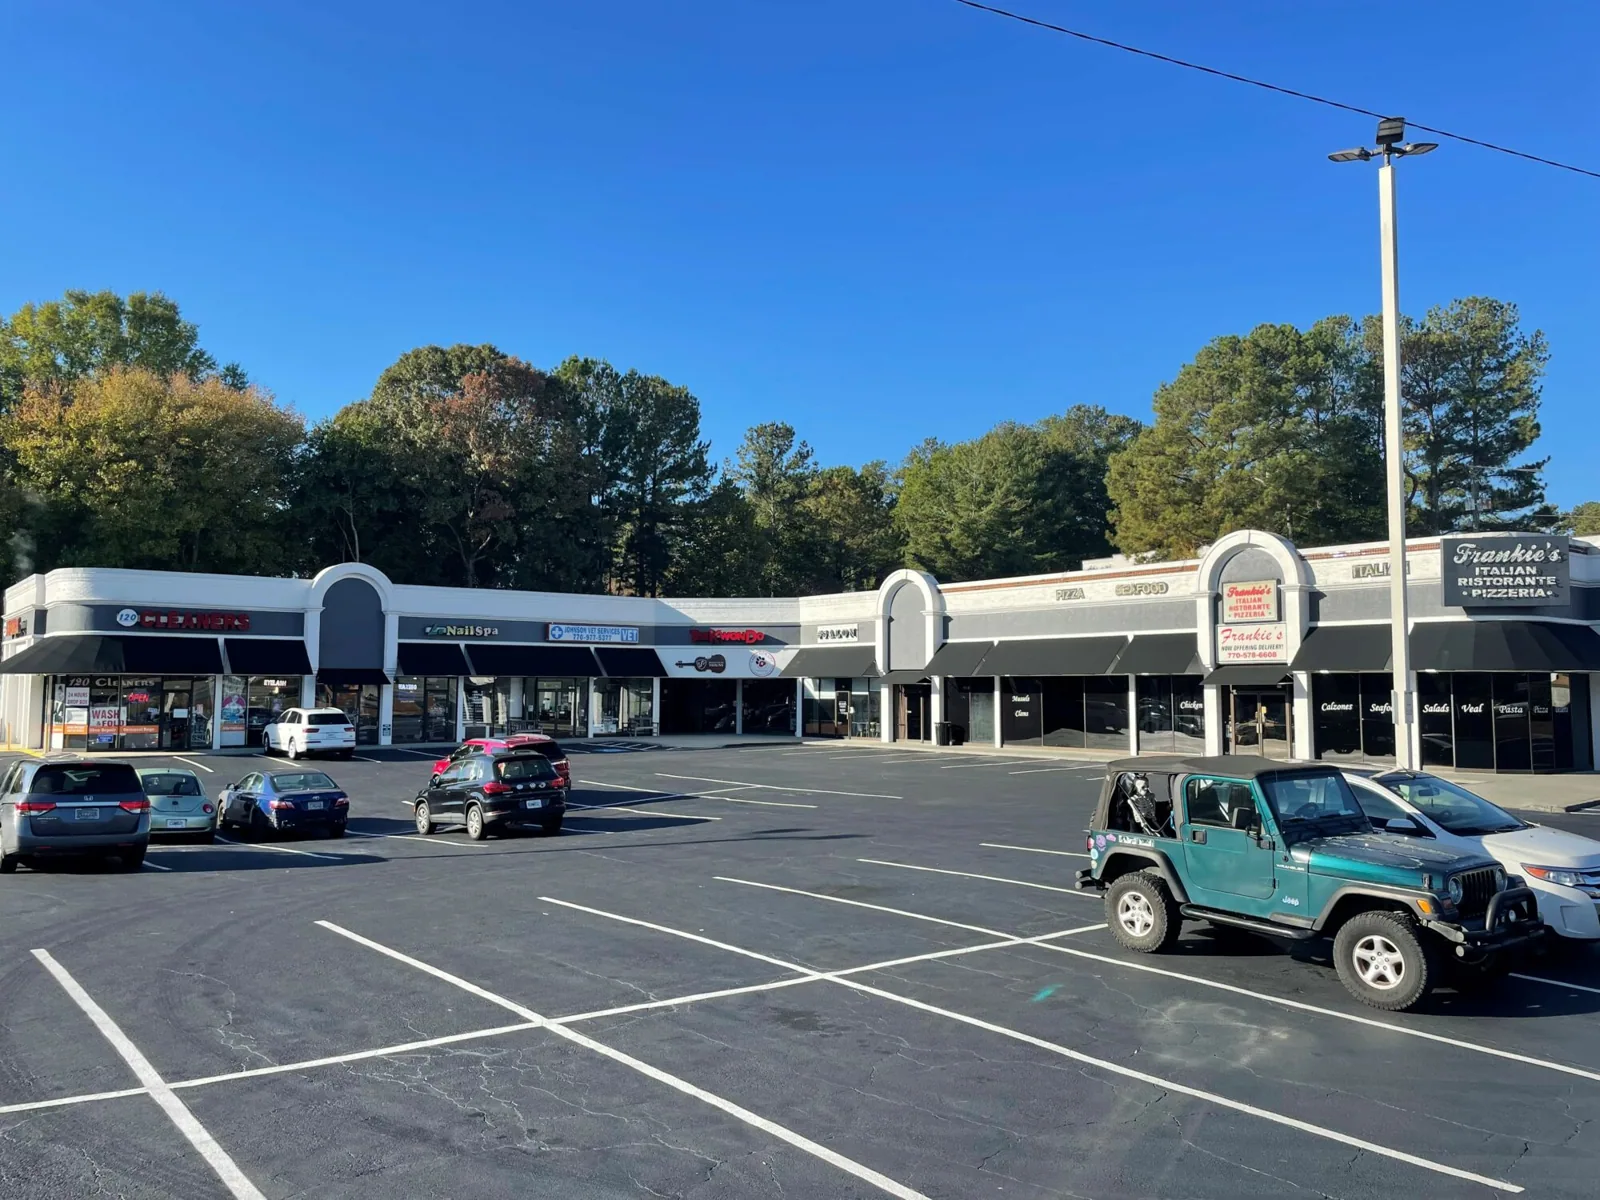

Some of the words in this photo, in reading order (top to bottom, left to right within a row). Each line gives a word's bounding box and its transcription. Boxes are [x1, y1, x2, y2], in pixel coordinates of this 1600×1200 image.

[1453, 541, 1561, 564] Frankie's
[1475, 566, 1537, 576] ITALIAN
[1457, 576, 1556, 586] RISTORANTE
[1115, 582, 1169, 596] SEAFOOD
[1227, 584, 1272, 598] Frankie's
[1471, 588, 1546, 598] PIZZERIA
[1056, 588, 1085, 601] PIZZA
[1228, 604, 1271, 612] RISTORANTE
[119, 613, 137, 621] 120
[140, 609, 250, 631] CLEANERS
[446, 625, 474, 636] Nail
[564, 626, 587, 634] JOHNSON
[597, 627, 620, 635] SERVICES
[622, 629, 638, 641] VET
[1221, 626, 1283, 644] Frankie's
[69, 677, 90, 687] 120
[263, 679, 287, 687] EYELASH
[128, 693, 149, 703] OPEN
[1180, 700, 1203, 710] Chicken
[1321, 701, 1353, 711] Calzones
[1422, 703, 1450, 713] Salads
[1461, 703, 1485, 713] Veal
[1498, 704, 1523, 714] Pasta
[92, 709, 120, 719] WASH
[1282, 895, 1300, 906] Jeep
